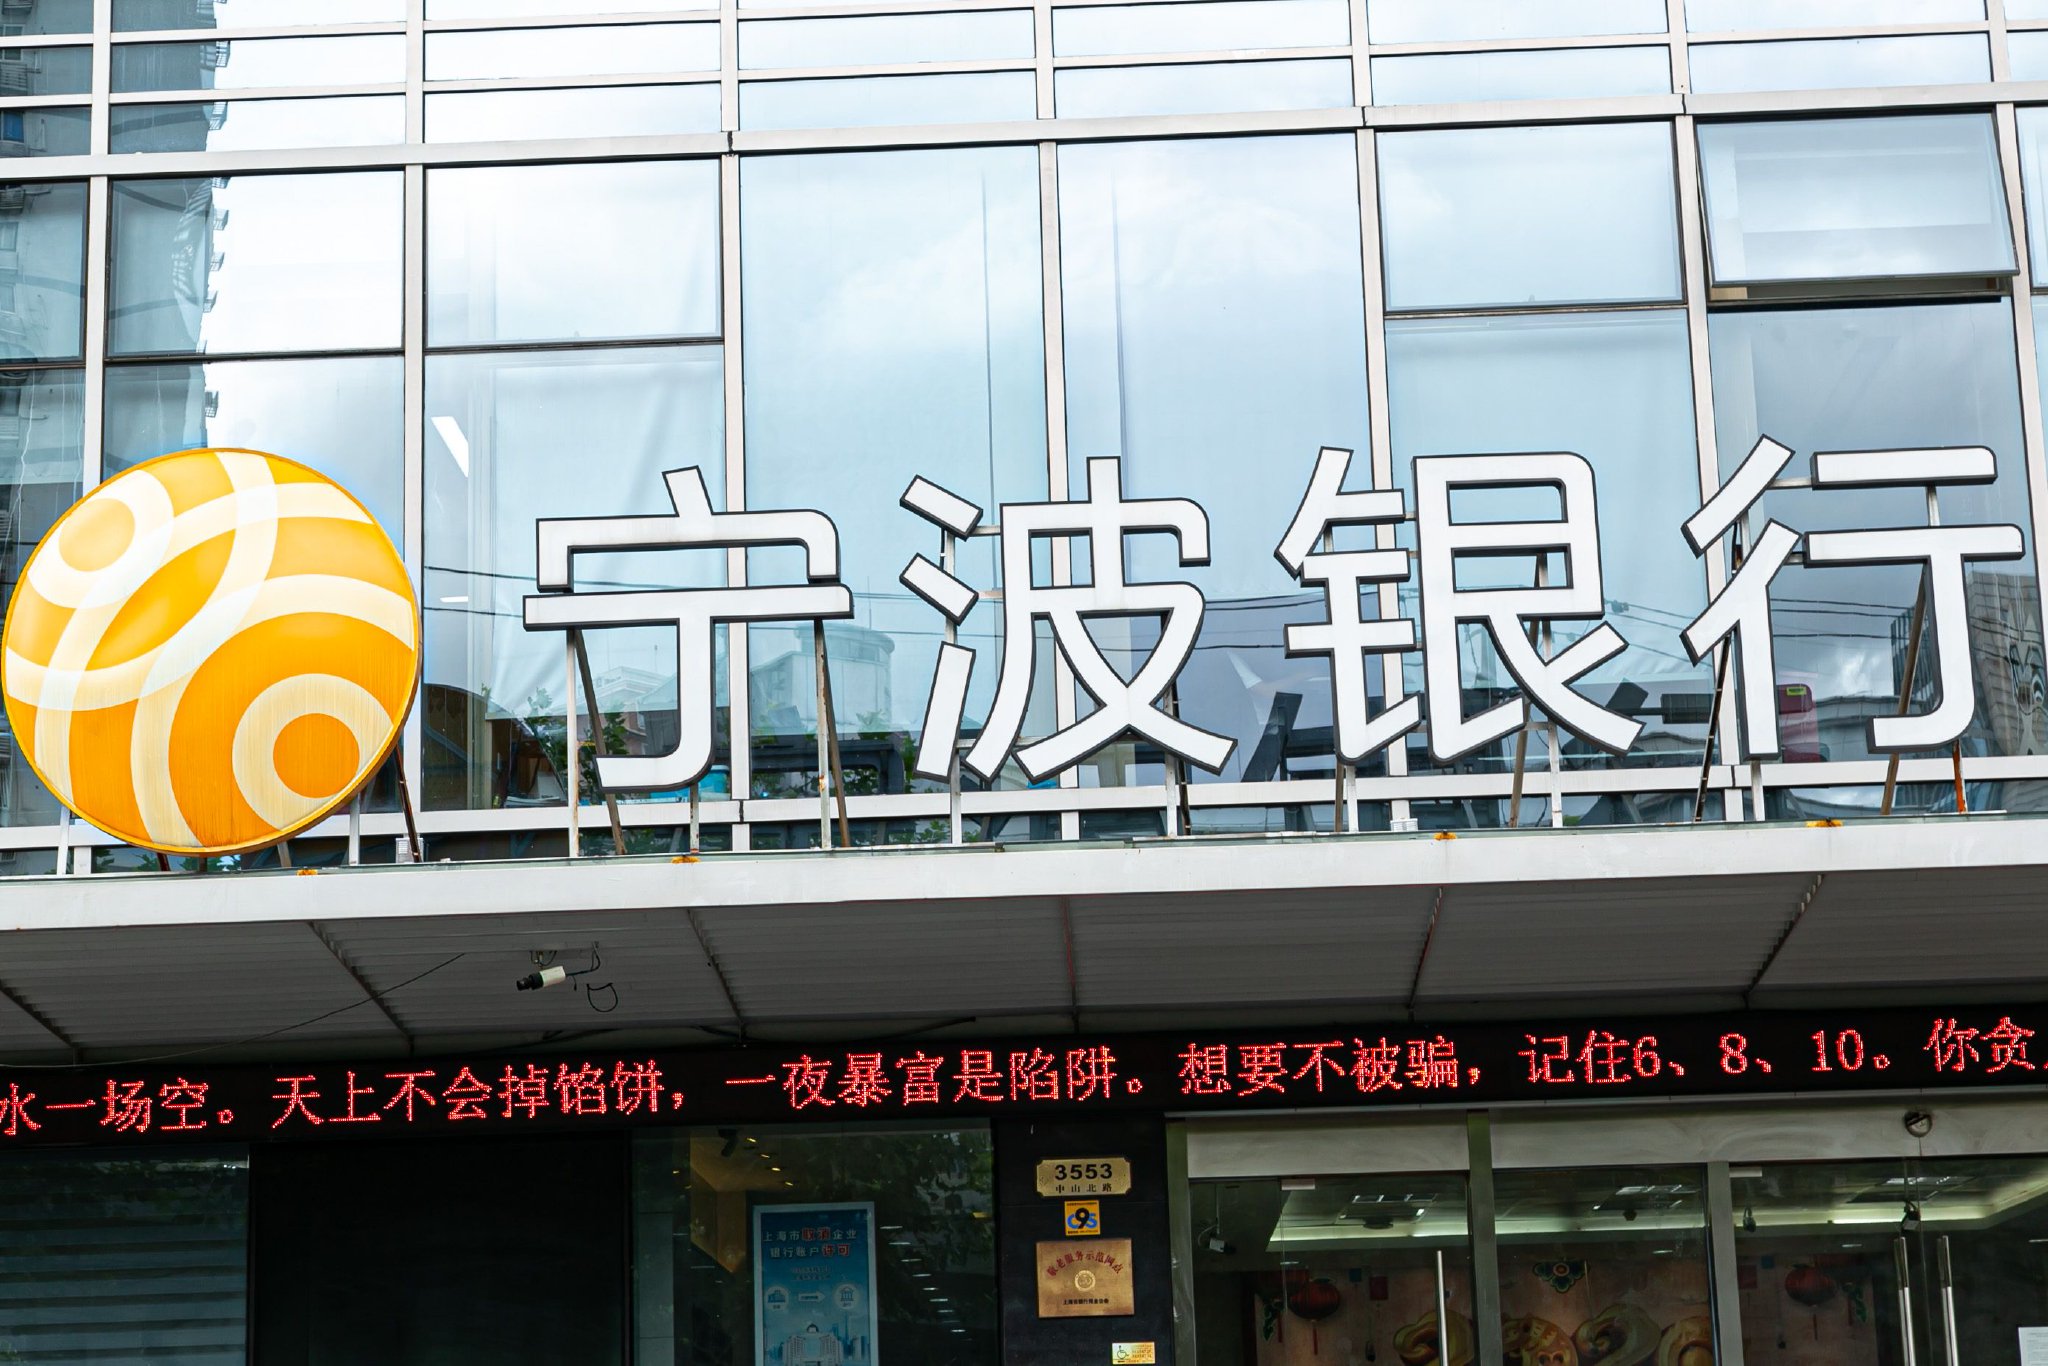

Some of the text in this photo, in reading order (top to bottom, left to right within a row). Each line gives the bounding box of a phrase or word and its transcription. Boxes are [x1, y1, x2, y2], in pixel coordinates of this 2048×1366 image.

[523, 433, 2026, 793] 宁波银行
[1055, 1163, 1113, 1181] 3553
[1055, 1183, 1113, 1194] 中山北路
